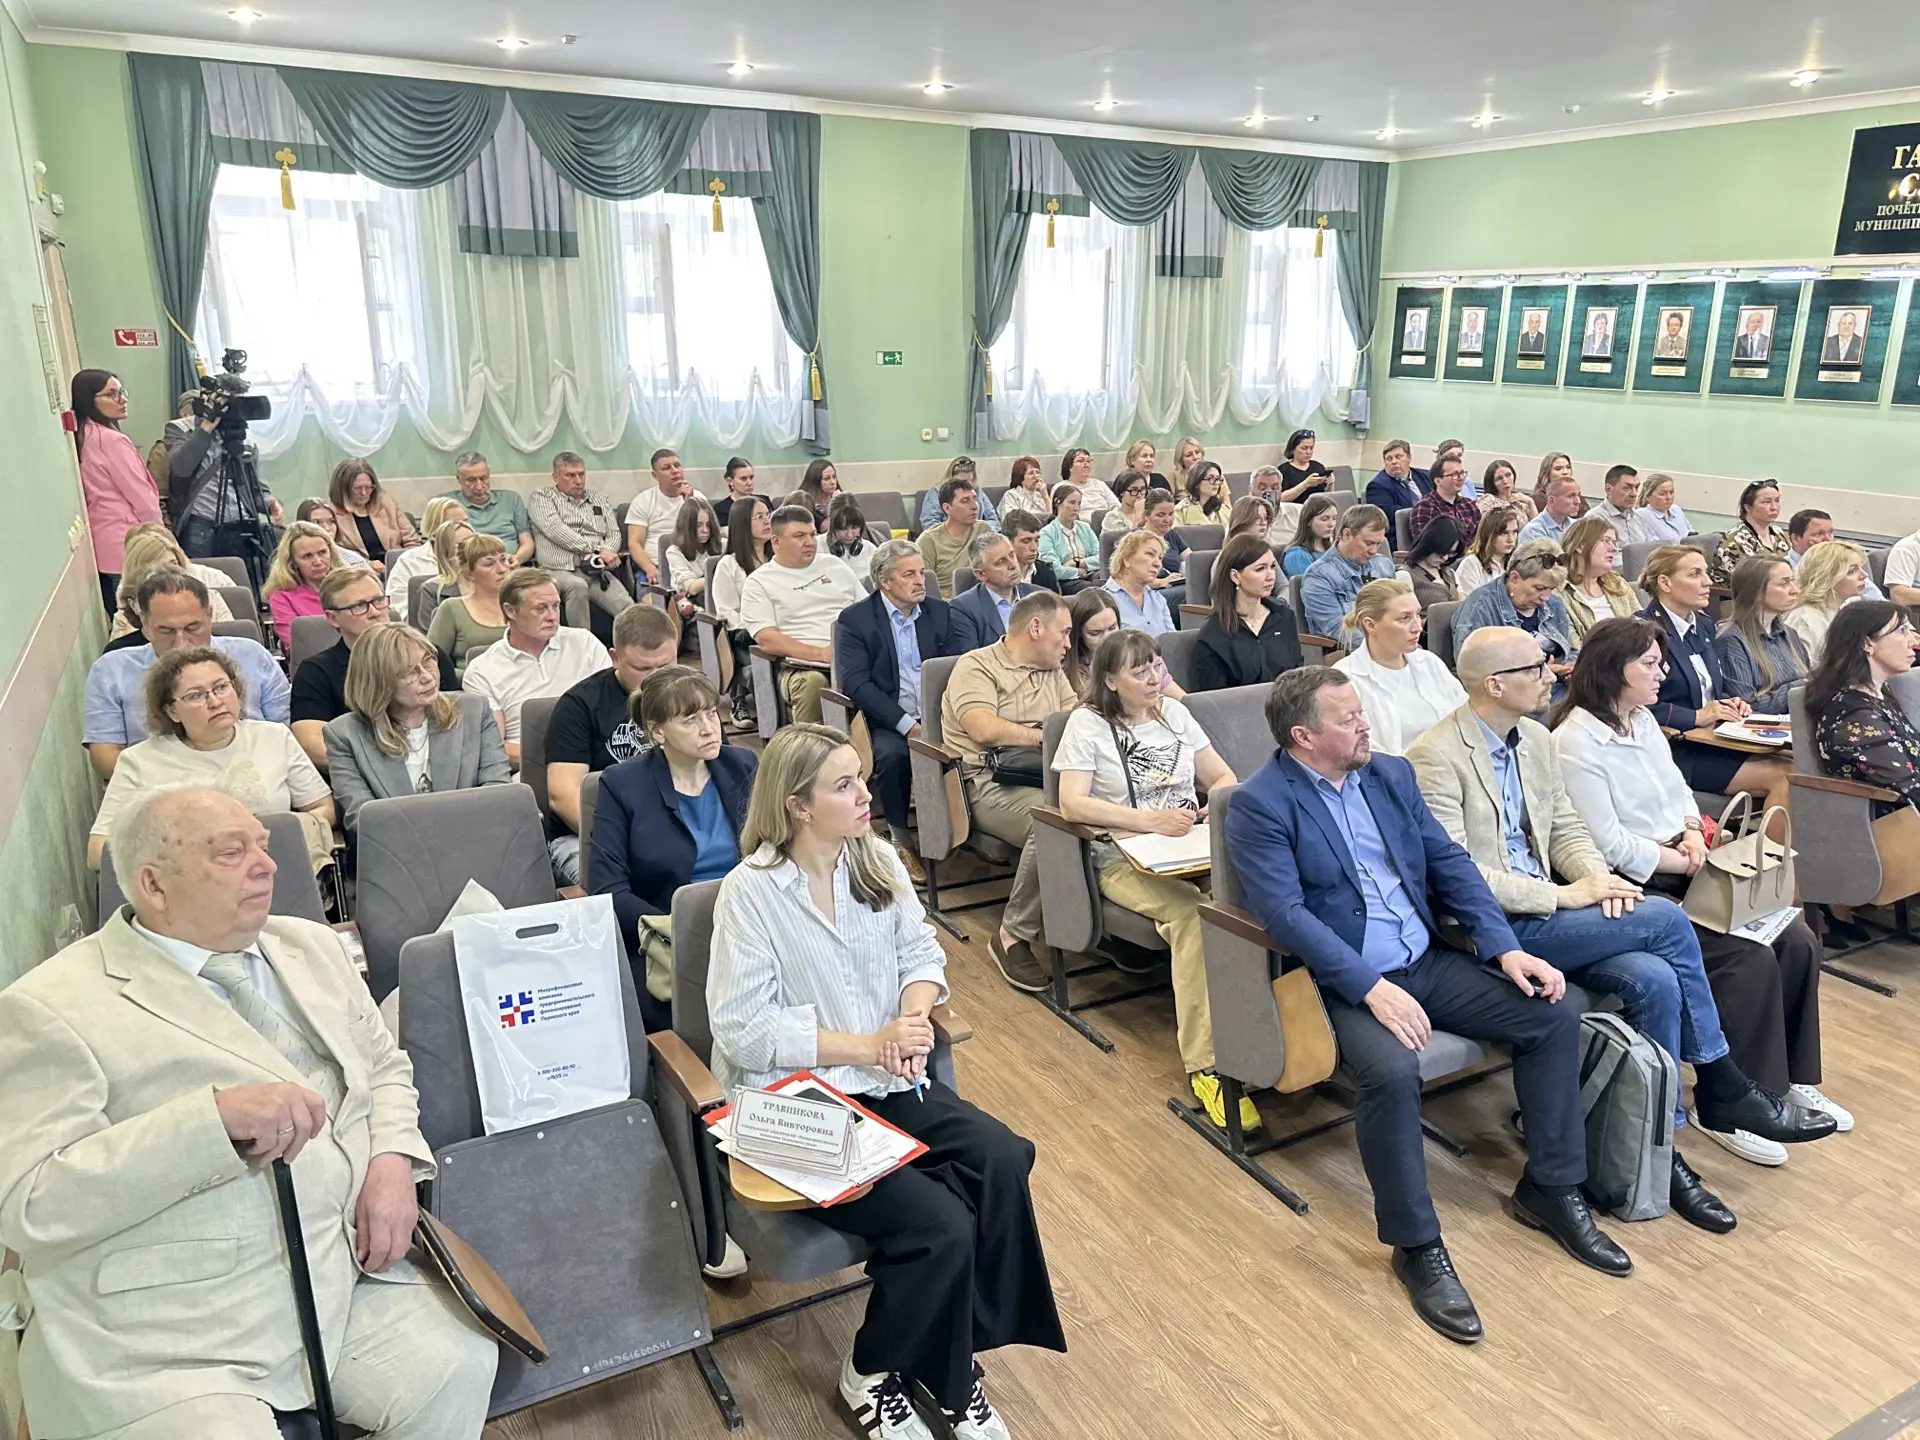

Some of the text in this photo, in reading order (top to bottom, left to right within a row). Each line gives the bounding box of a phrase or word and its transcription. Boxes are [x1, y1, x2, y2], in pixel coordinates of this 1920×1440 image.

[1898, 172, 1920, 197] С
[749, 1112, 776, 1126] Ольга
[777, 1117, 834, 1137] Викторовна
